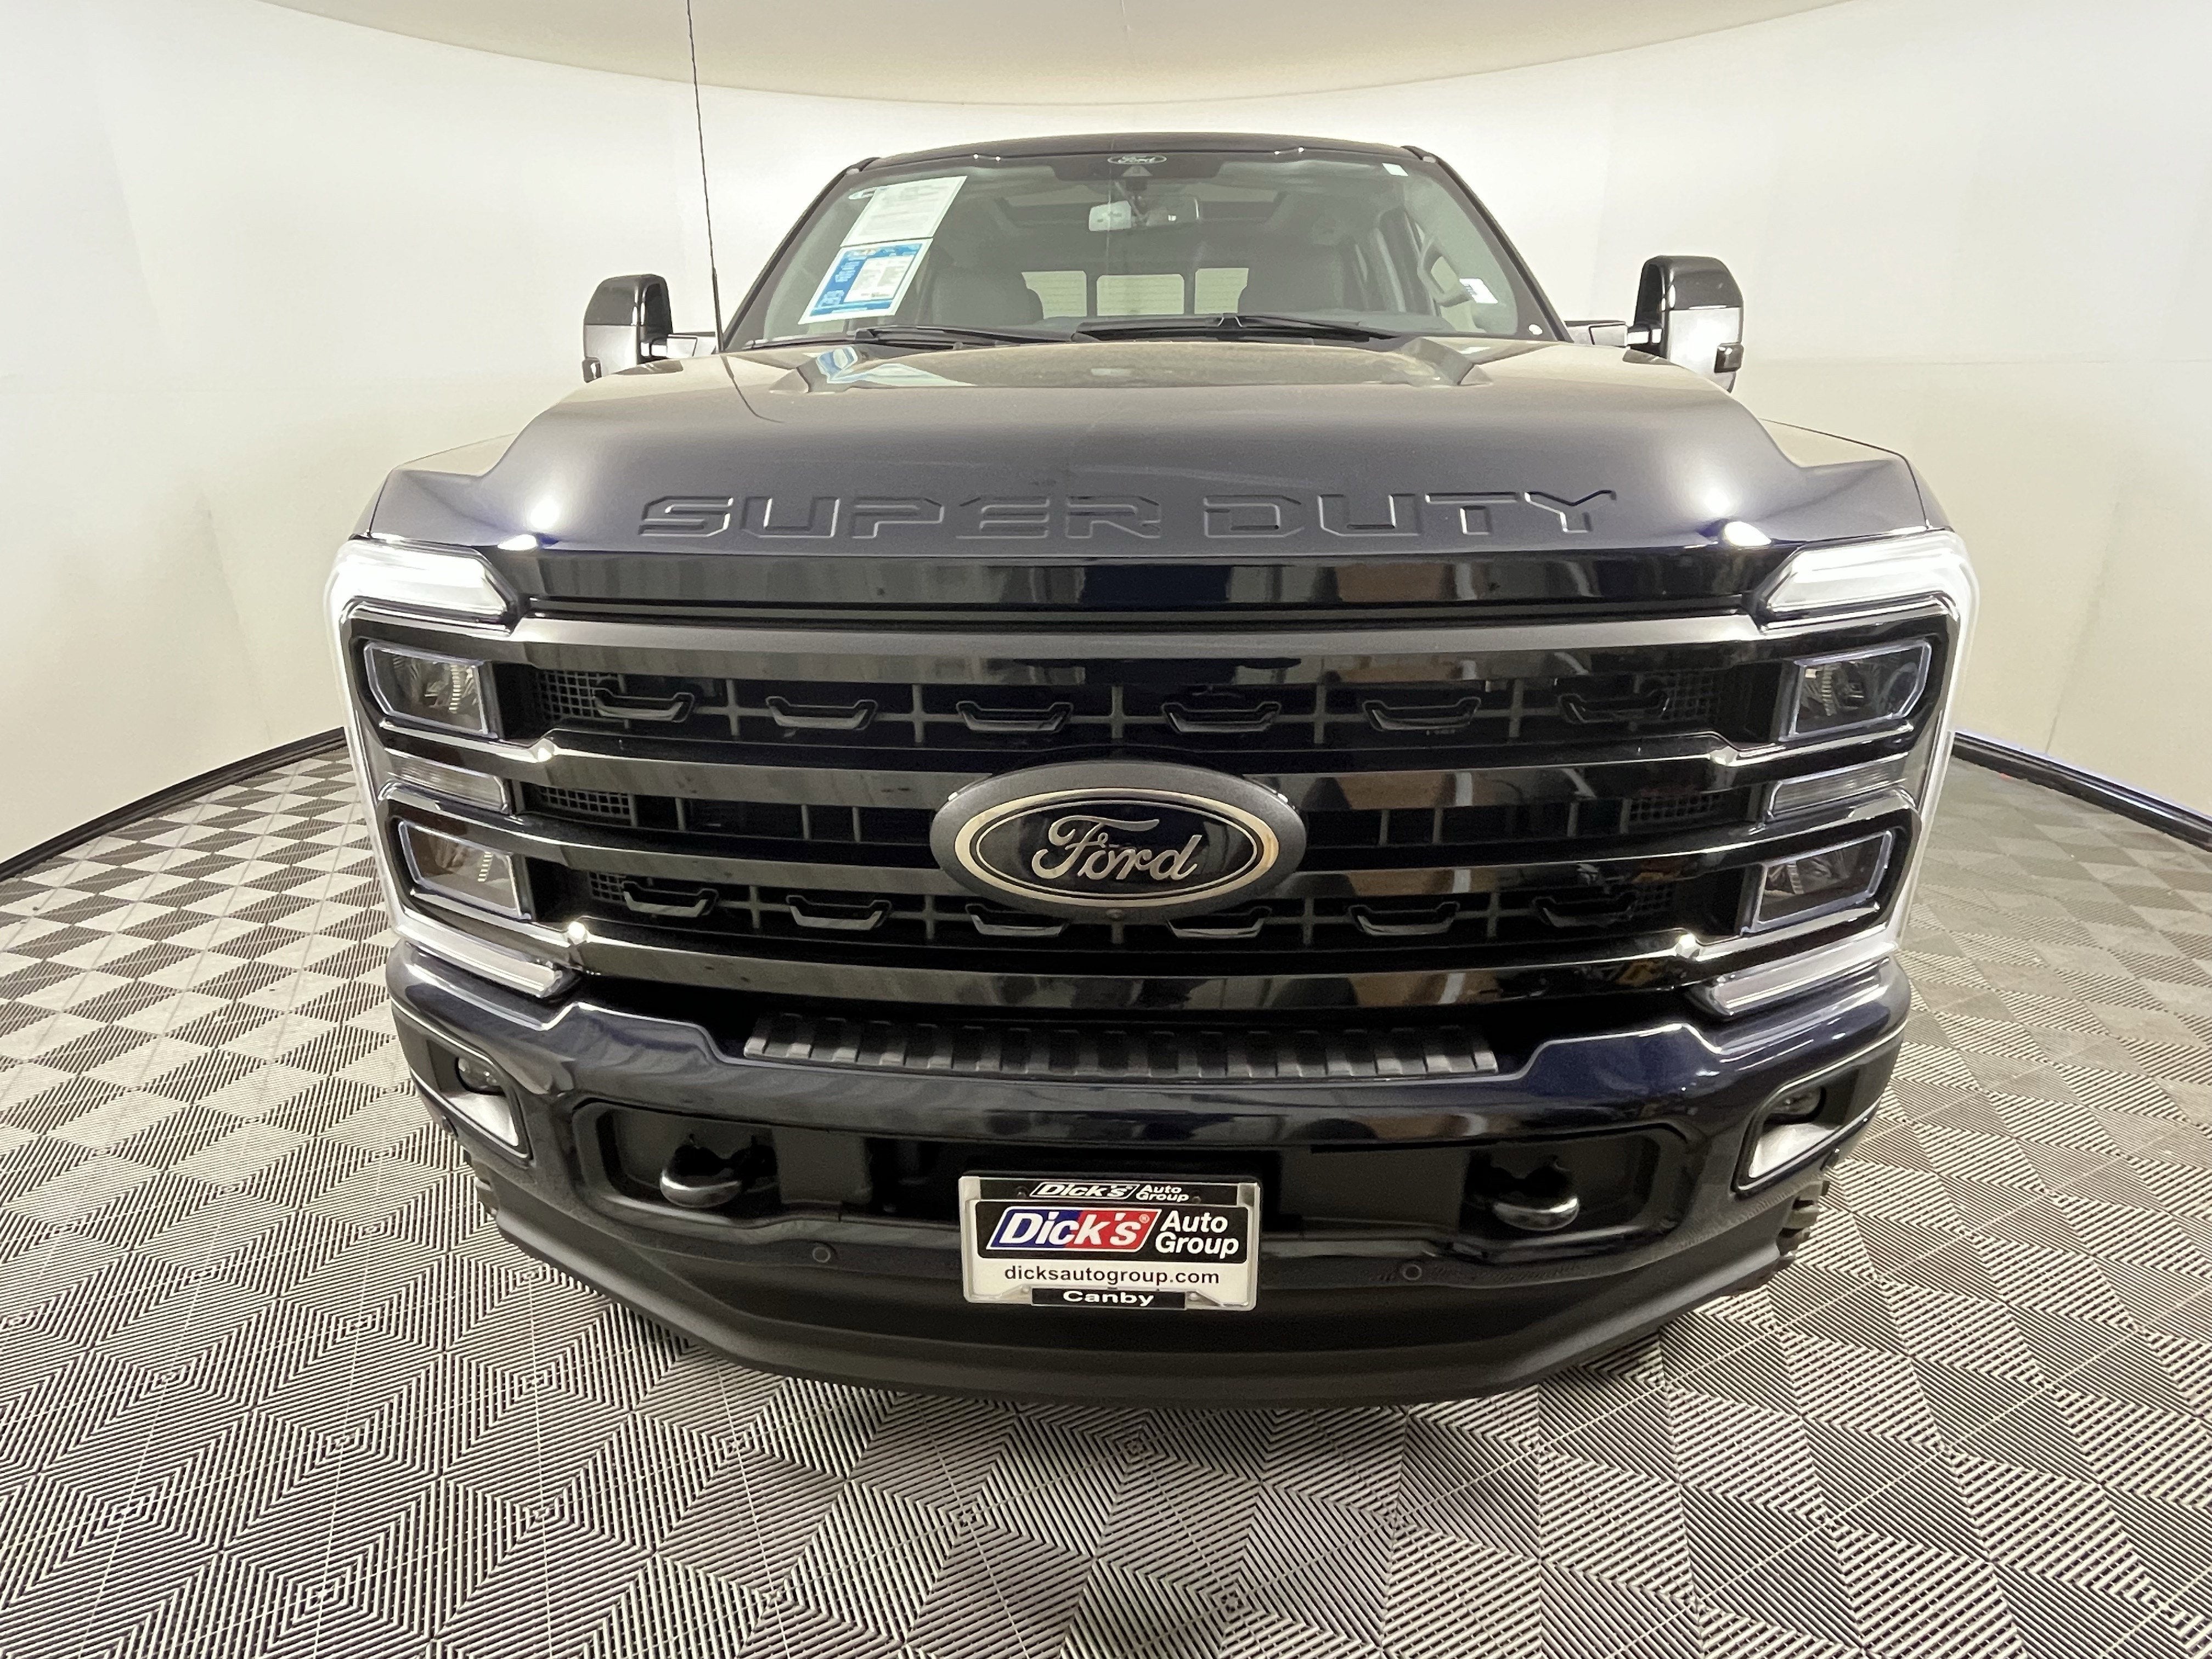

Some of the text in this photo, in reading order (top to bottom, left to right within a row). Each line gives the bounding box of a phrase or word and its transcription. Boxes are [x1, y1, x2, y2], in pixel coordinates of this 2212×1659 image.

[638, 490, 1616, 538] SUPER DUTY
[1032, 815, 1203, 881] Ford
[1039, 1183, 1182, 1198] Dick's Auto
[1136, 1192, 1189, 1203] Group
[1000, 1210, 1228, 1246] Dick's Auto
[1155, 1232, 1239, 1259] Group
[1005, 1265, 1220, 1285] dicksautogroup.com
[1063, 1290, 1154, 1307] Canby
